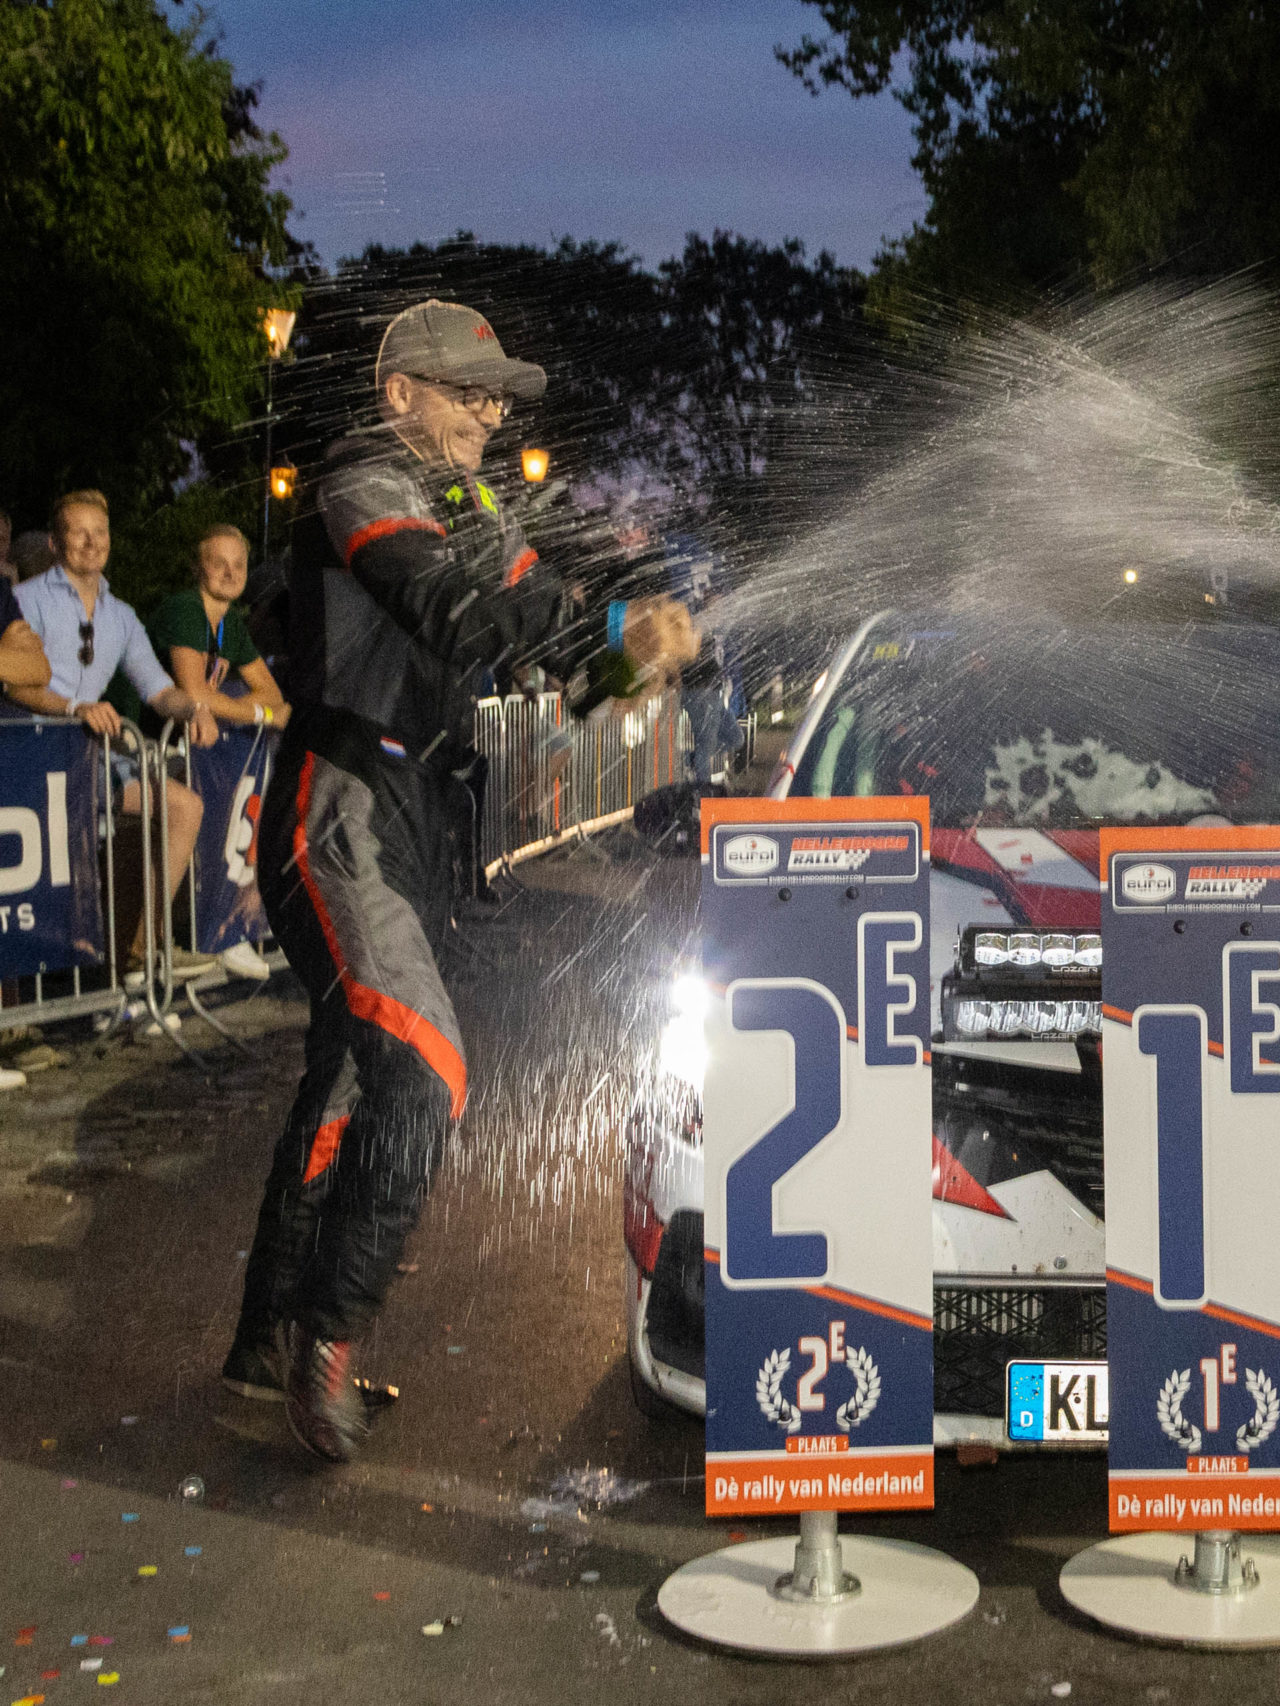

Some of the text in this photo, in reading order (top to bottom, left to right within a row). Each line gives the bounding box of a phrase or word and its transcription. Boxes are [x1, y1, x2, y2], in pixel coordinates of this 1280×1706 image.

[728, 849, 774, 861] eurol
[793, 852, 842, 865] RALLY
[1127, 878, 1171, 889] eurol
[1190, 881, 1238, 893] RALLY
[1020, 1411, 1034, 1428] D
[797, 1437, 838, 1453] PLAATS
[1198, 1457, 1238, 1473] PLAATS
[715, 1470, 924, 1503] Dè rally van Nederland
[1117, 1493, 1141, 1517] Dè
[1145, 1492, 1186, 1521] rally
[1190, 1498, 1224, 1517] van
